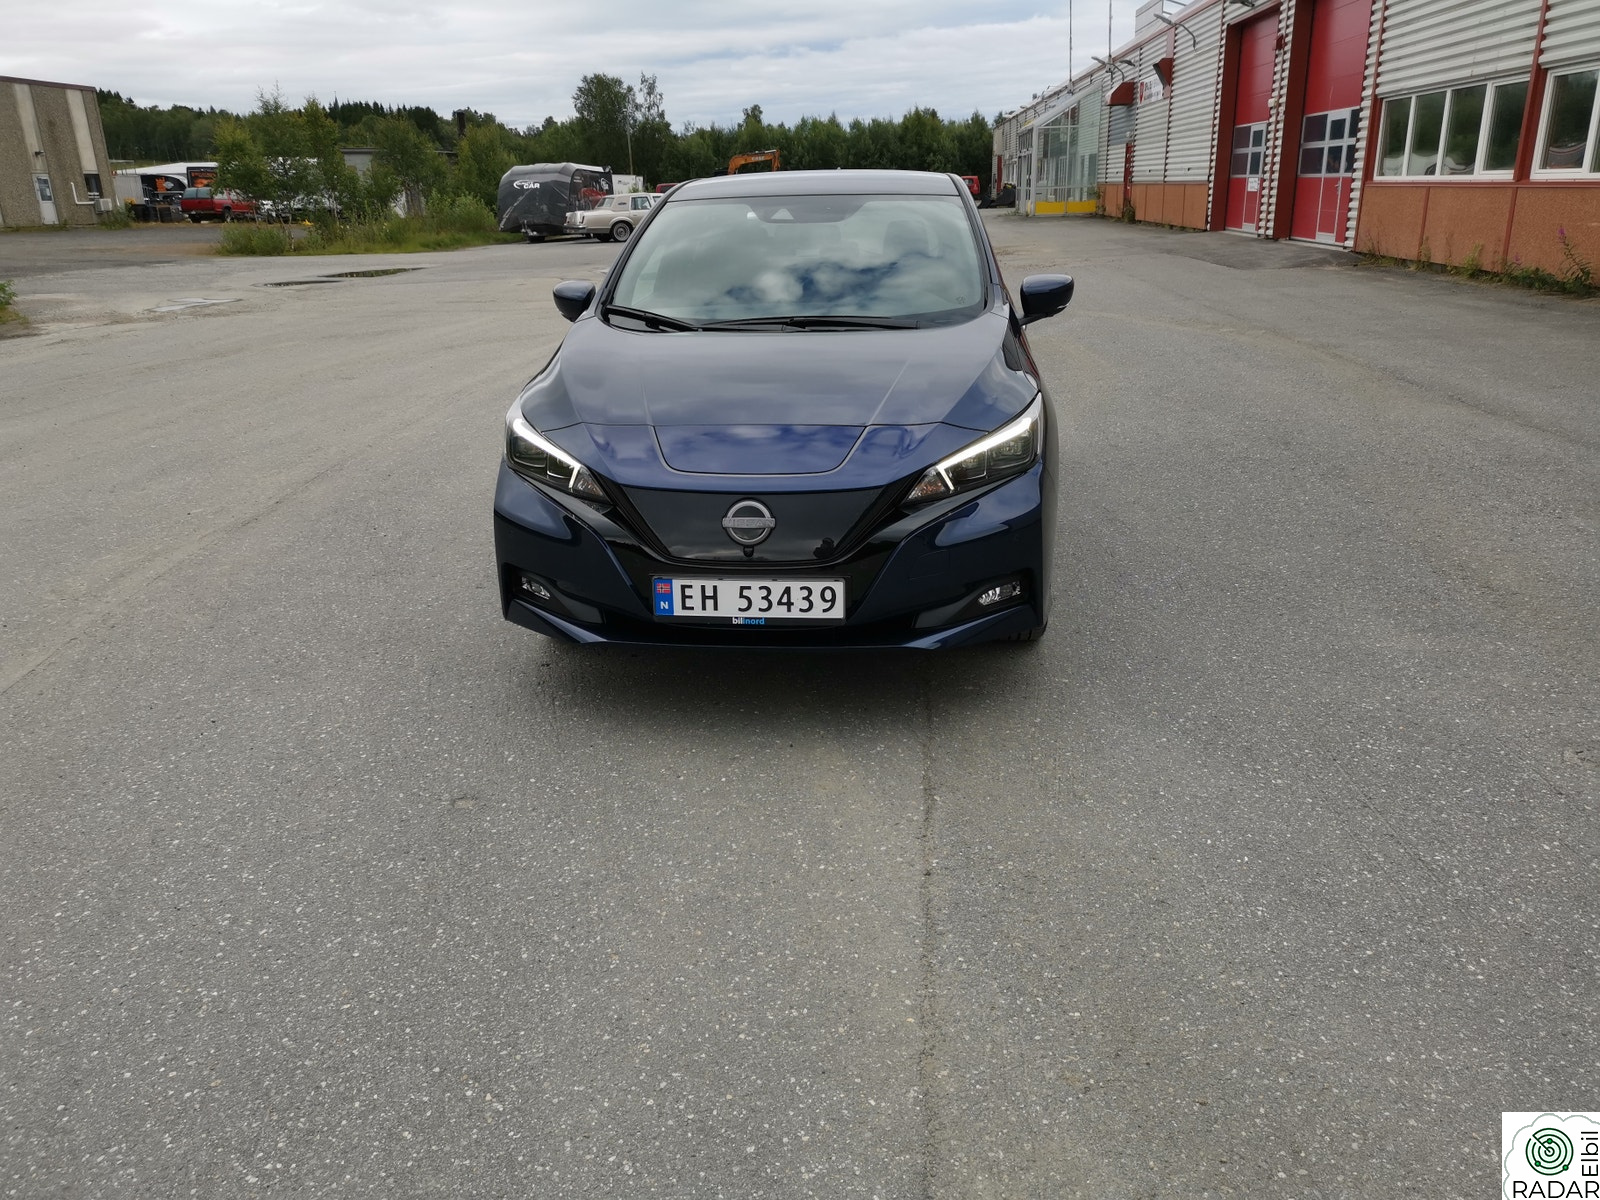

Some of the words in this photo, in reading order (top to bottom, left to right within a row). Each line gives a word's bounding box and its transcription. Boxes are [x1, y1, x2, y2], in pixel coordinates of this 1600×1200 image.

[724, 518, 775, 528] NISSAN
[680, 584, 719, 611] EH
[738, 585, 837, 613] 53439
[660, 601, 669, 610] N
